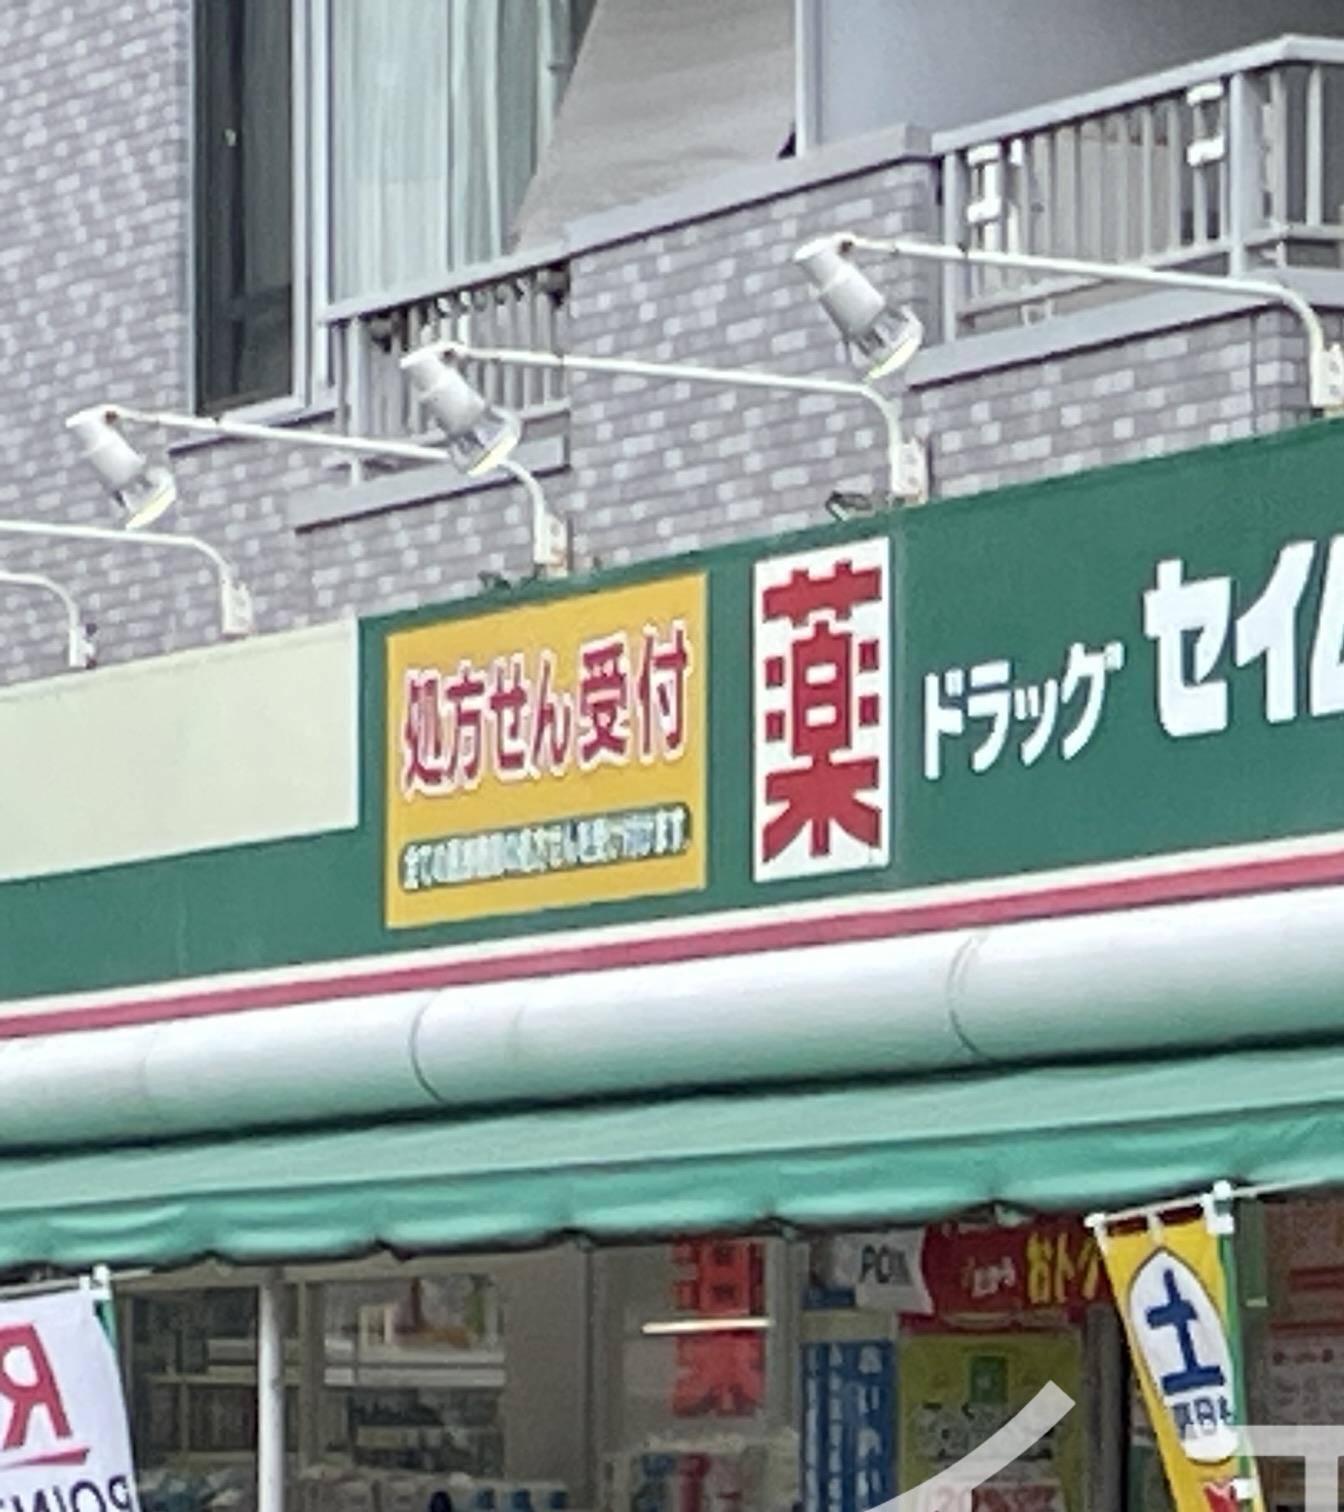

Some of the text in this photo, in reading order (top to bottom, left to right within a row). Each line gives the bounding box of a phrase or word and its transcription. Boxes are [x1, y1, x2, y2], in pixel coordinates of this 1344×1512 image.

[402, 618, 691, 802] 処方せん受付
[761, 558, 884, 864] 薬
[924, 641, 1124, 780] ドラッグ
